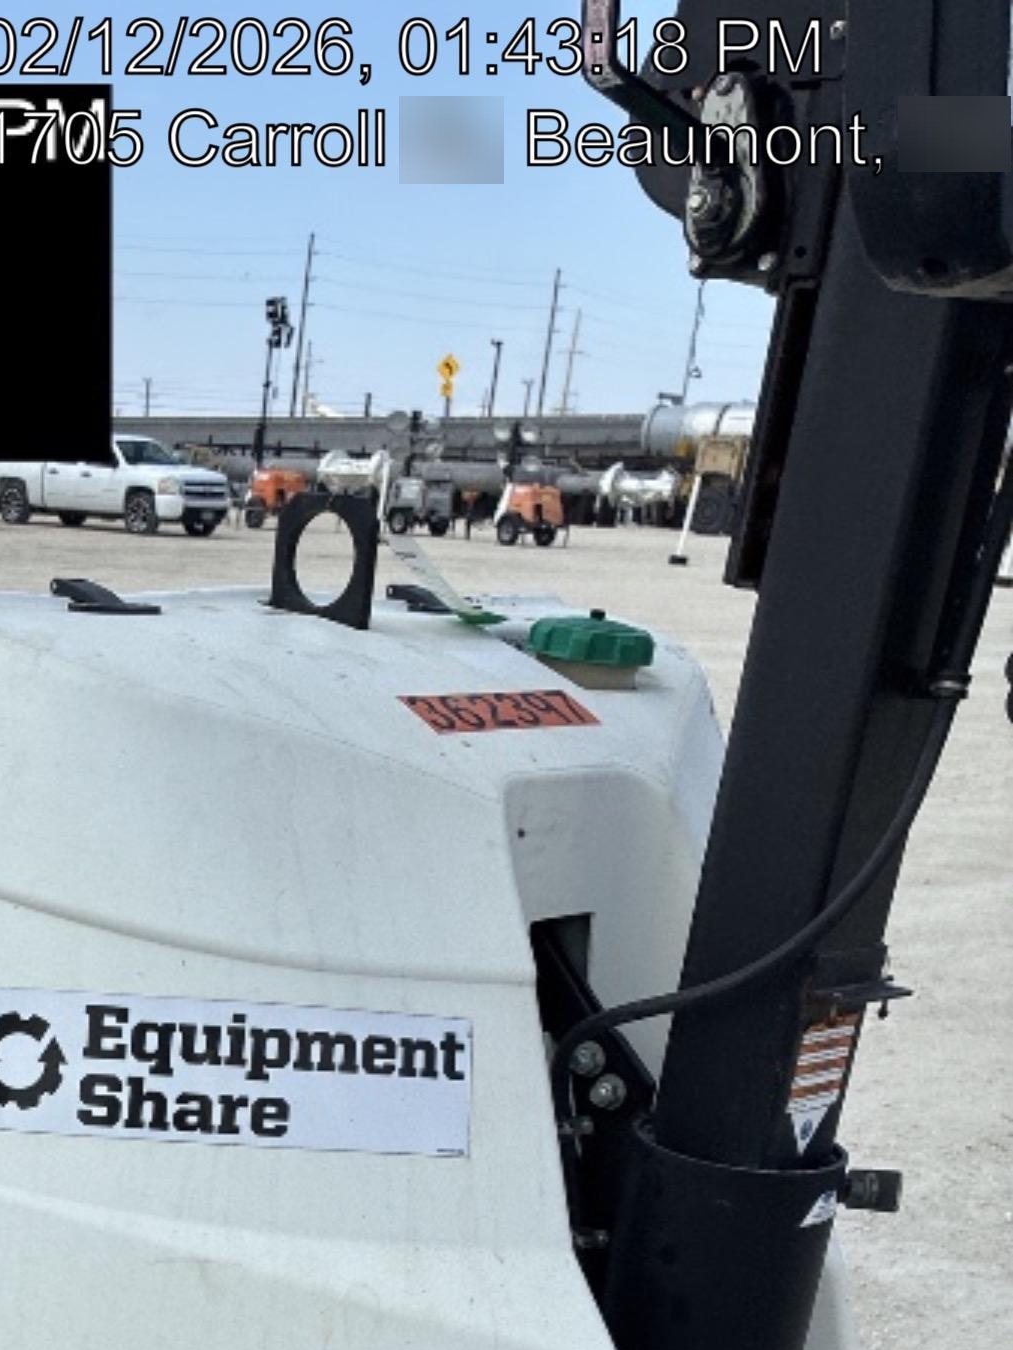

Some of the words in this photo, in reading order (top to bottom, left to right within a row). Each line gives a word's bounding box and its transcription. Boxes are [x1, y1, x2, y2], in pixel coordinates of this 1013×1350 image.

[402, 690, 589, 730] 362397
[82, 1004, 466, 1081] Equipment
[76, 1073, 290, 1137] Share
